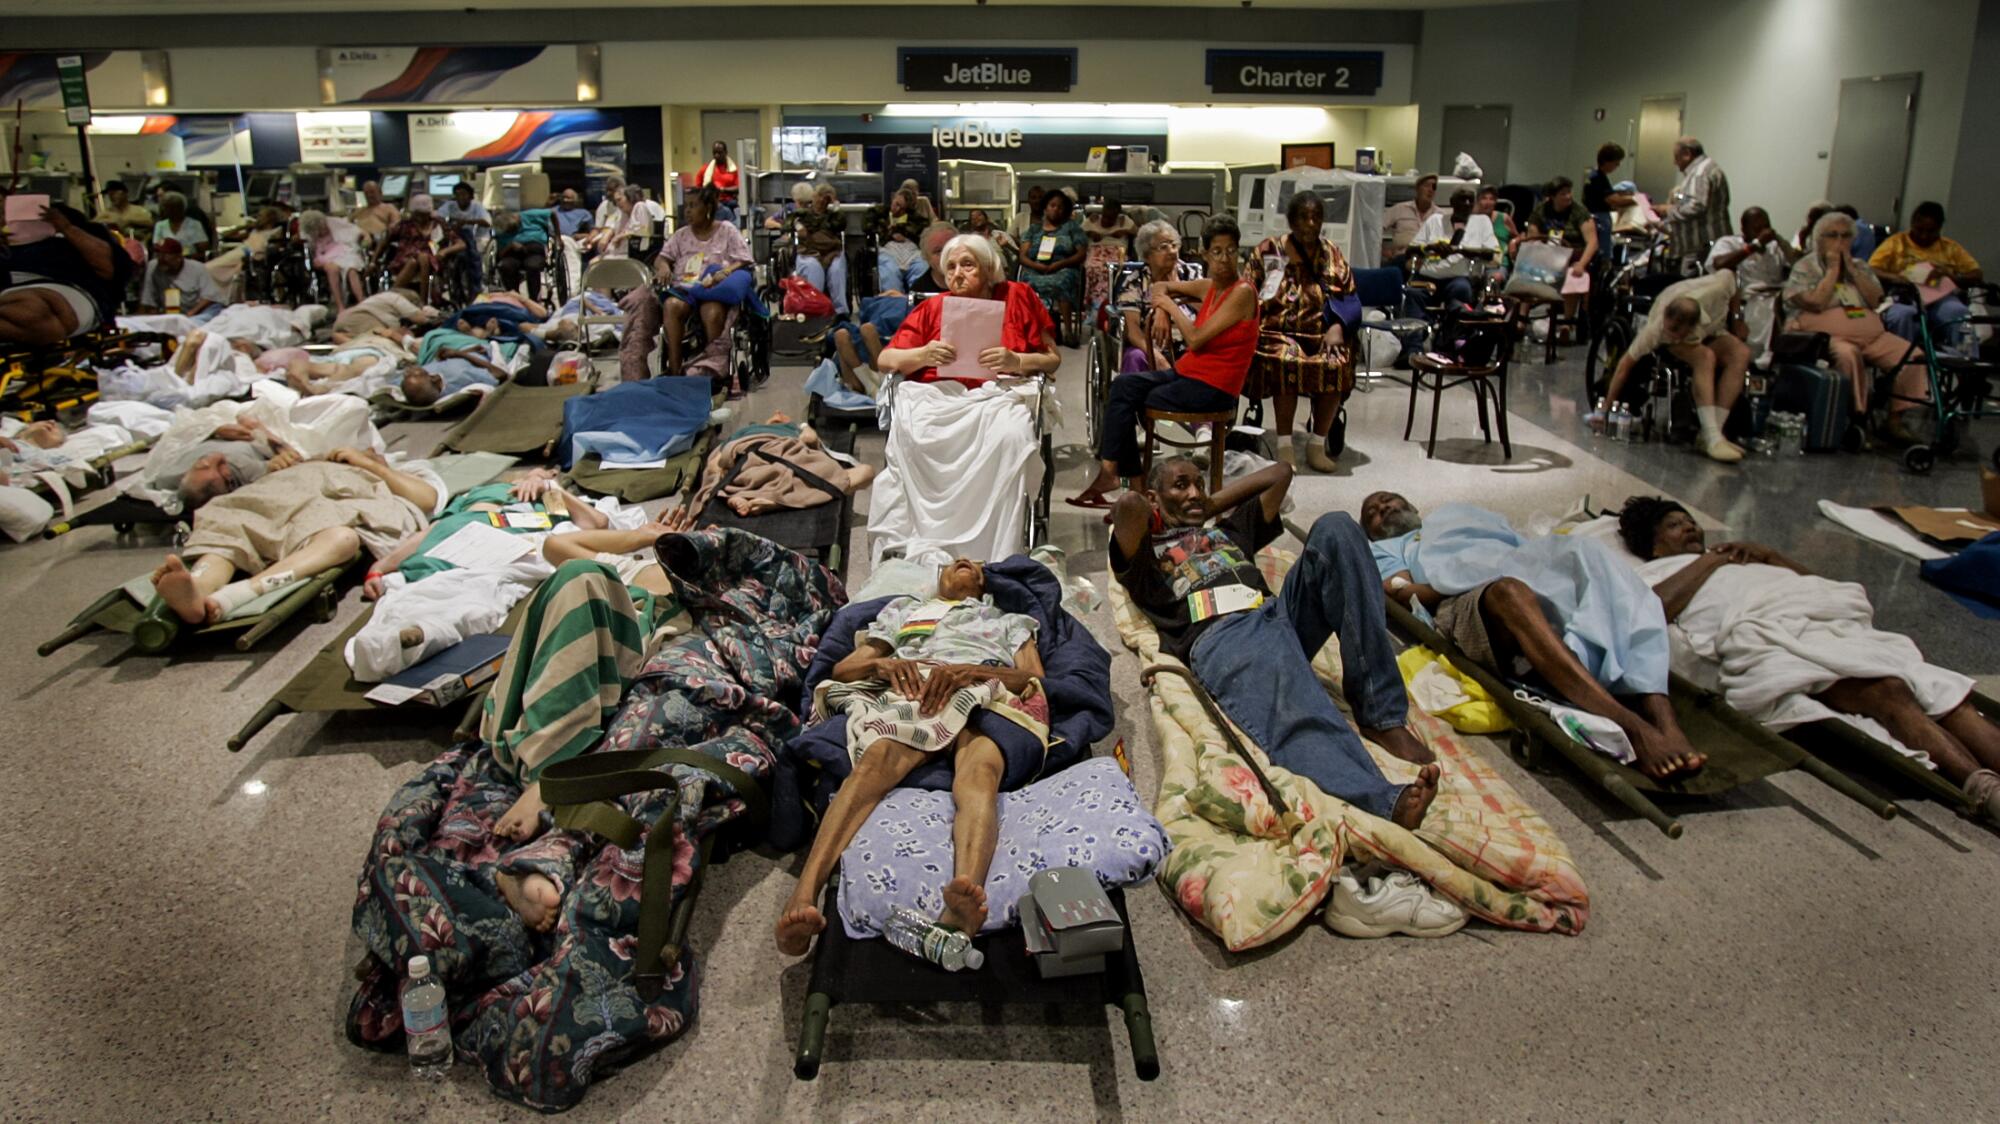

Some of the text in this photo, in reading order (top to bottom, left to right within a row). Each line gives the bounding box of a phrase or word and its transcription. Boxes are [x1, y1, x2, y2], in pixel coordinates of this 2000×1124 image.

[350, 51, 377, 60] Delta
[943, 63, 1032, 84] JetBlue
[1240, 66, 1349, 88] Charter 2
[427, 116, 456, 127] Delta
[931, 121, 1023, 148] jetBlue
